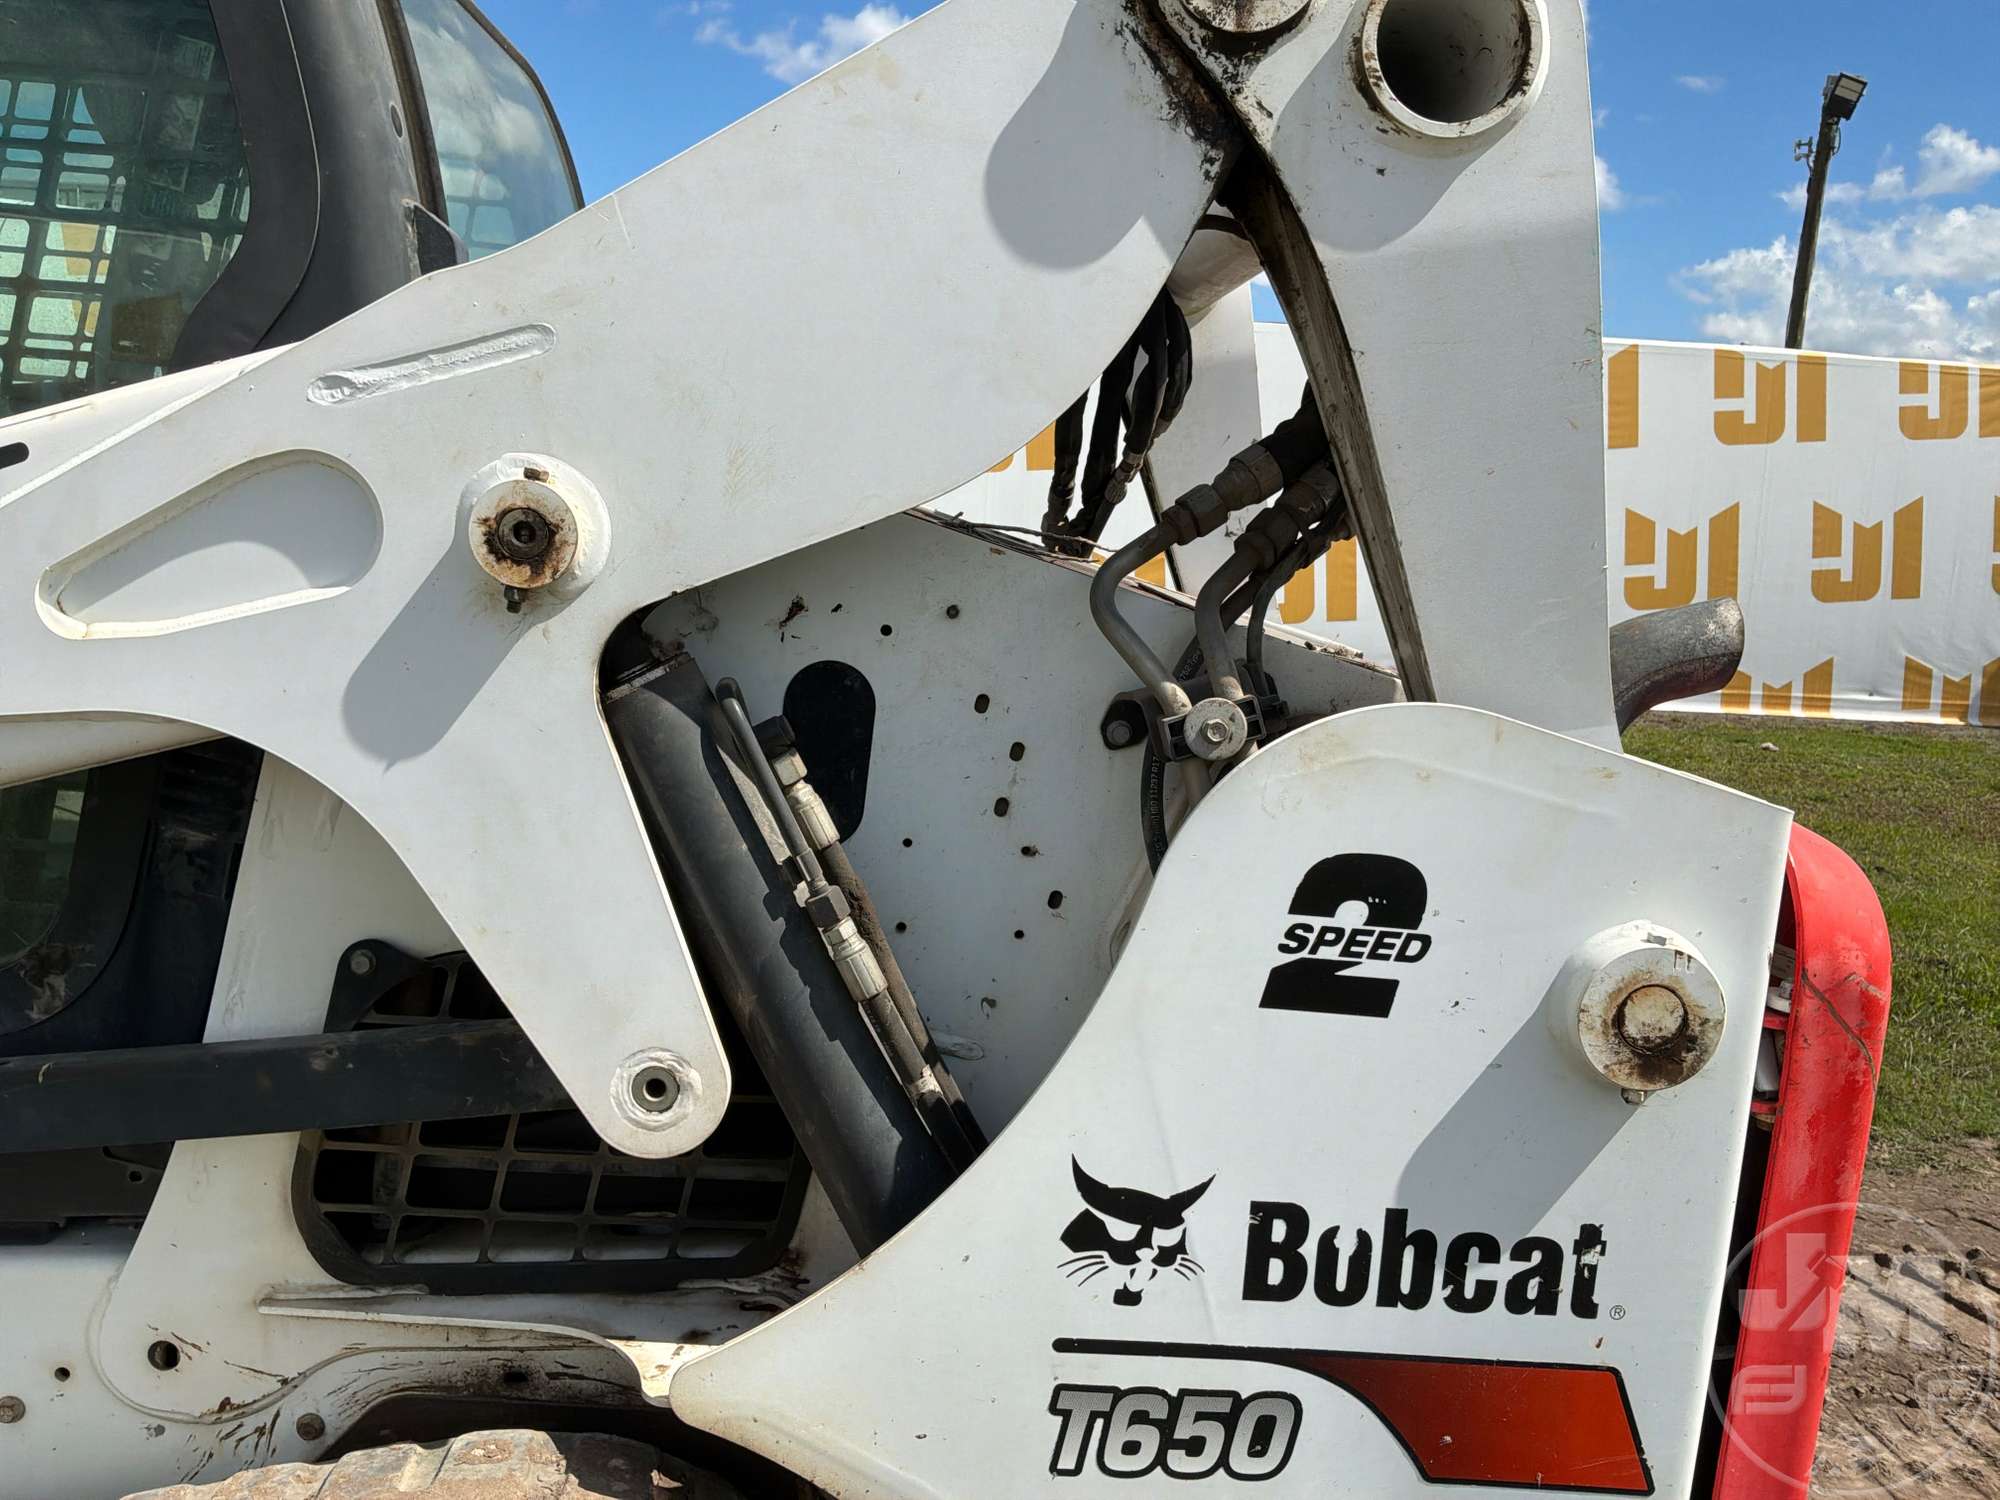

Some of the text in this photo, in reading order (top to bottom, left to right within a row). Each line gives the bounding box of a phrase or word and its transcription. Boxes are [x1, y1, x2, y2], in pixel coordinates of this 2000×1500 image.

[1258, 852, 1428, 1019] 2
[1277, 922, 1433, 965] SPEED
[1242, 1200, 1608, 1319] Bobcat
[1049, 1382, 1303, 1482] T650
